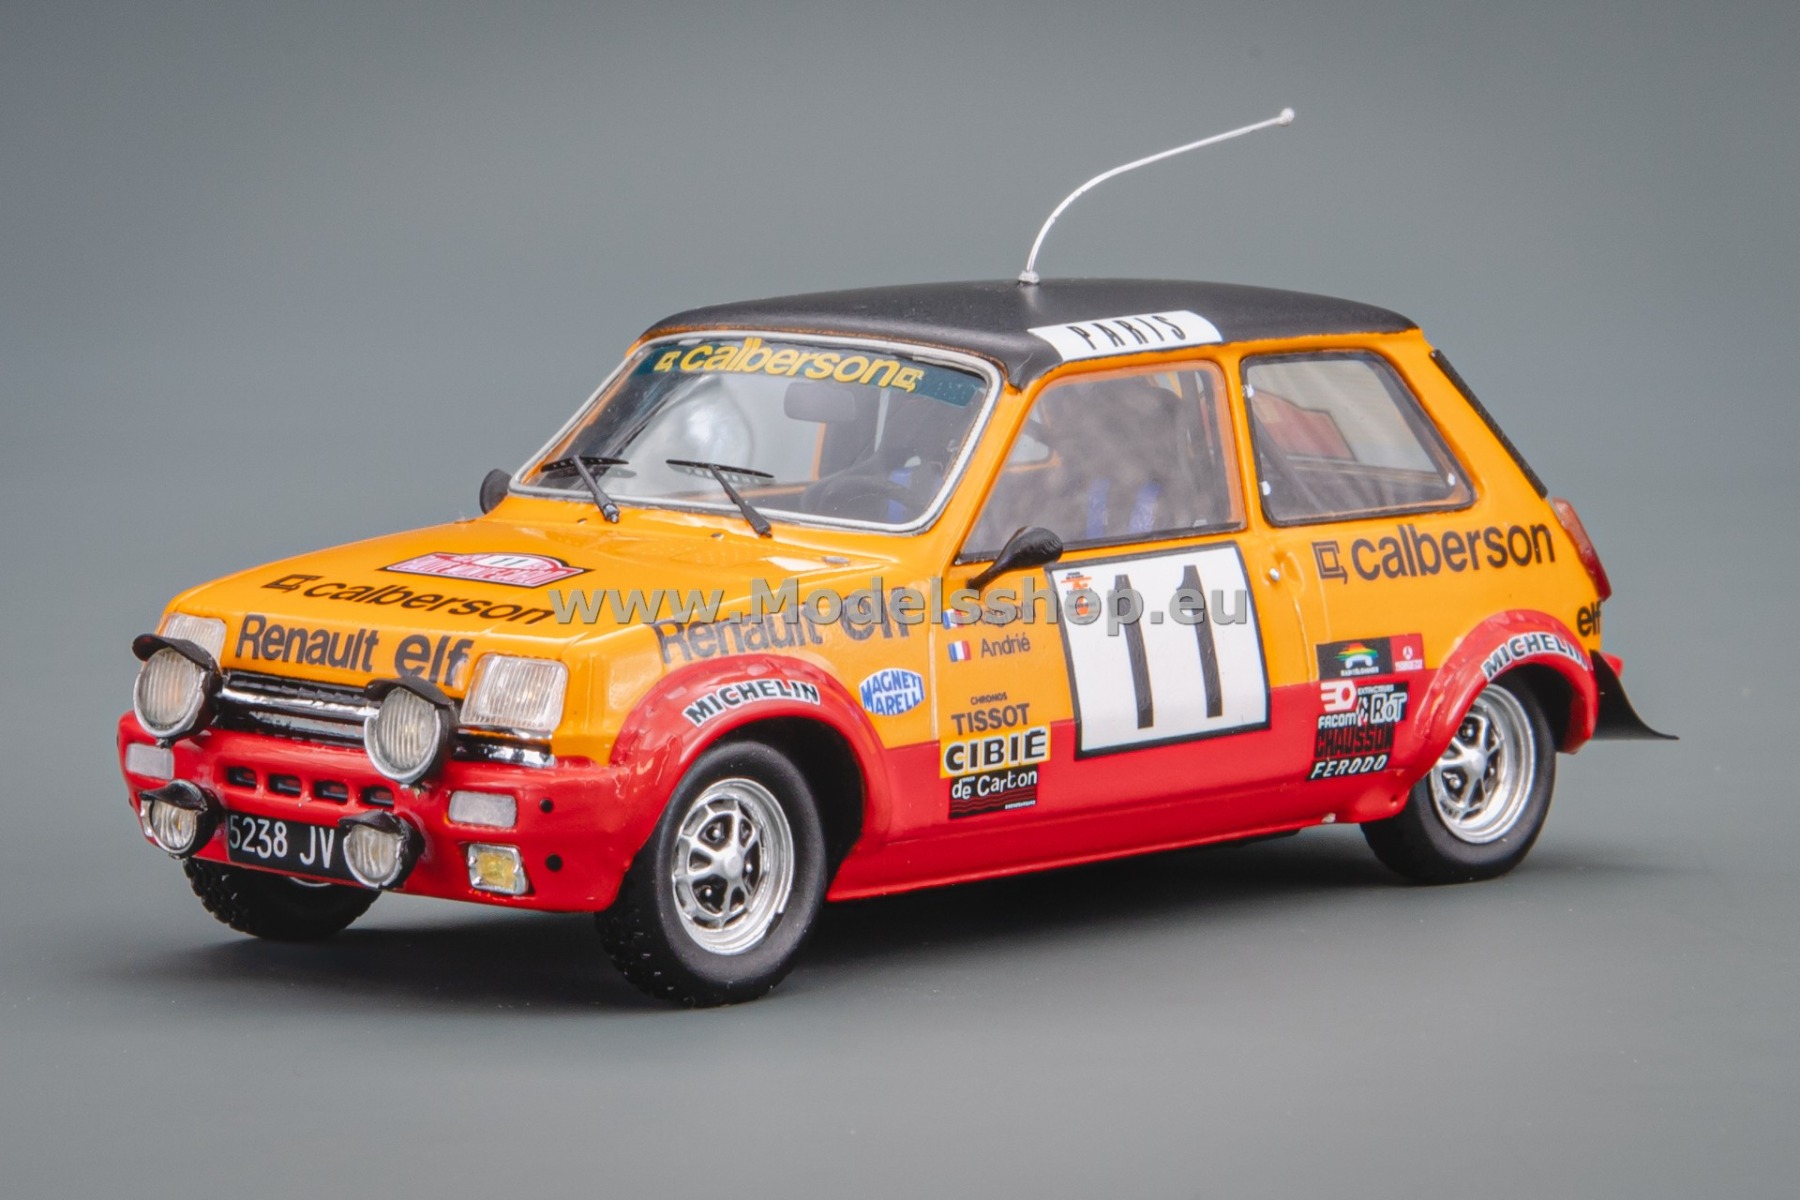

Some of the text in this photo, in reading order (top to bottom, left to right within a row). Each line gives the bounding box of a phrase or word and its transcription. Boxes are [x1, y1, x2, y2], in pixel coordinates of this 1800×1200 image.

[1066, 315, 1186, 351] PARIS
[680, 336, 901, 388] calberson
[1352, 523, 1556, 581] calberson
[303, 582, 556, 625] calberson
[235, 613, 475, 687] Renault elf
[652, 602, 823, 664] Renault
[981, 632, 1031, 659] Andrié
[1112, 564, 1223, 730] 11
[685, 680, 819, 725] MICHELIN
[951, 703, 1030, 736] TISSOT
[951, 770, 1038, 800] de Carton
[1311, 754, 1388, 779] FERODO
[229, 814, 335, 869] 5238 JV
